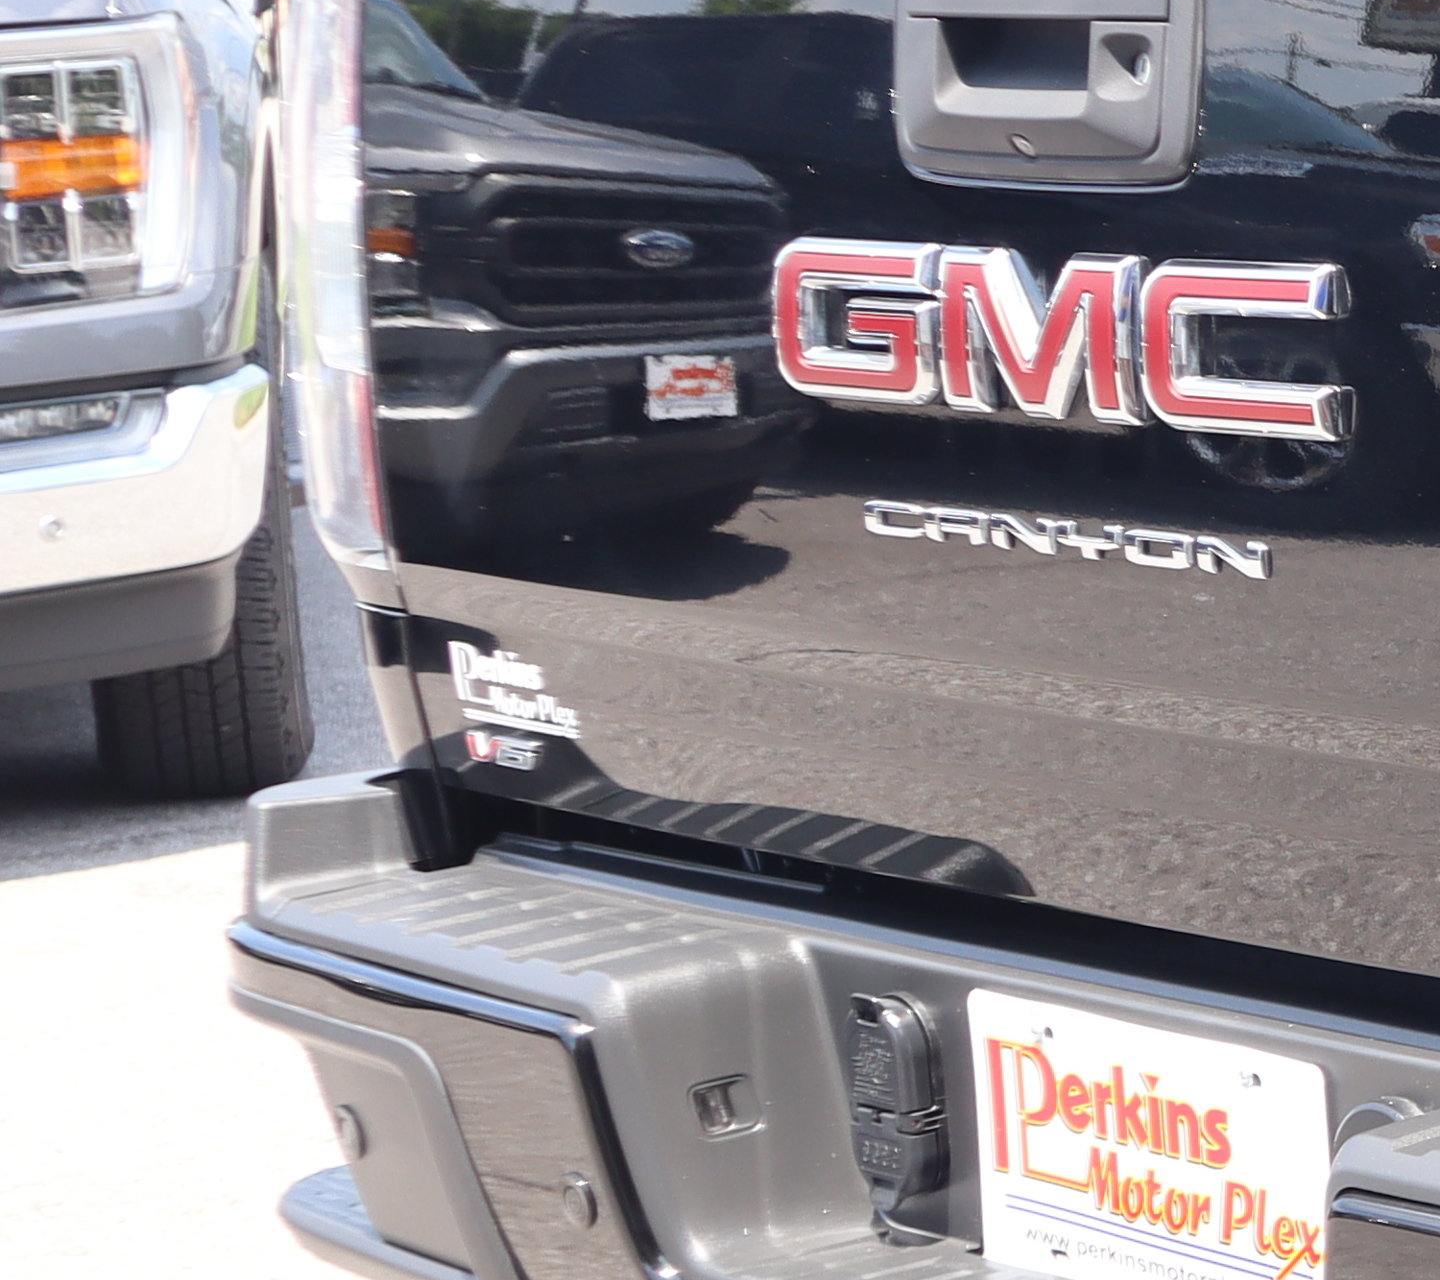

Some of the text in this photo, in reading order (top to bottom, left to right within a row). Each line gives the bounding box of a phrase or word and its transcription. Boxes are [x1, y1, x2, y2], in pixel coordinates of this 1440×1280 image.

[771, 236, 1357, 443] GMC
[864, 499, 1273, 581] CANYON
[465, 730, 544, 771] V6
[984, 1035, 1233, 1176] Perkins
[1086, 1146, 1211, 1235] Motor
